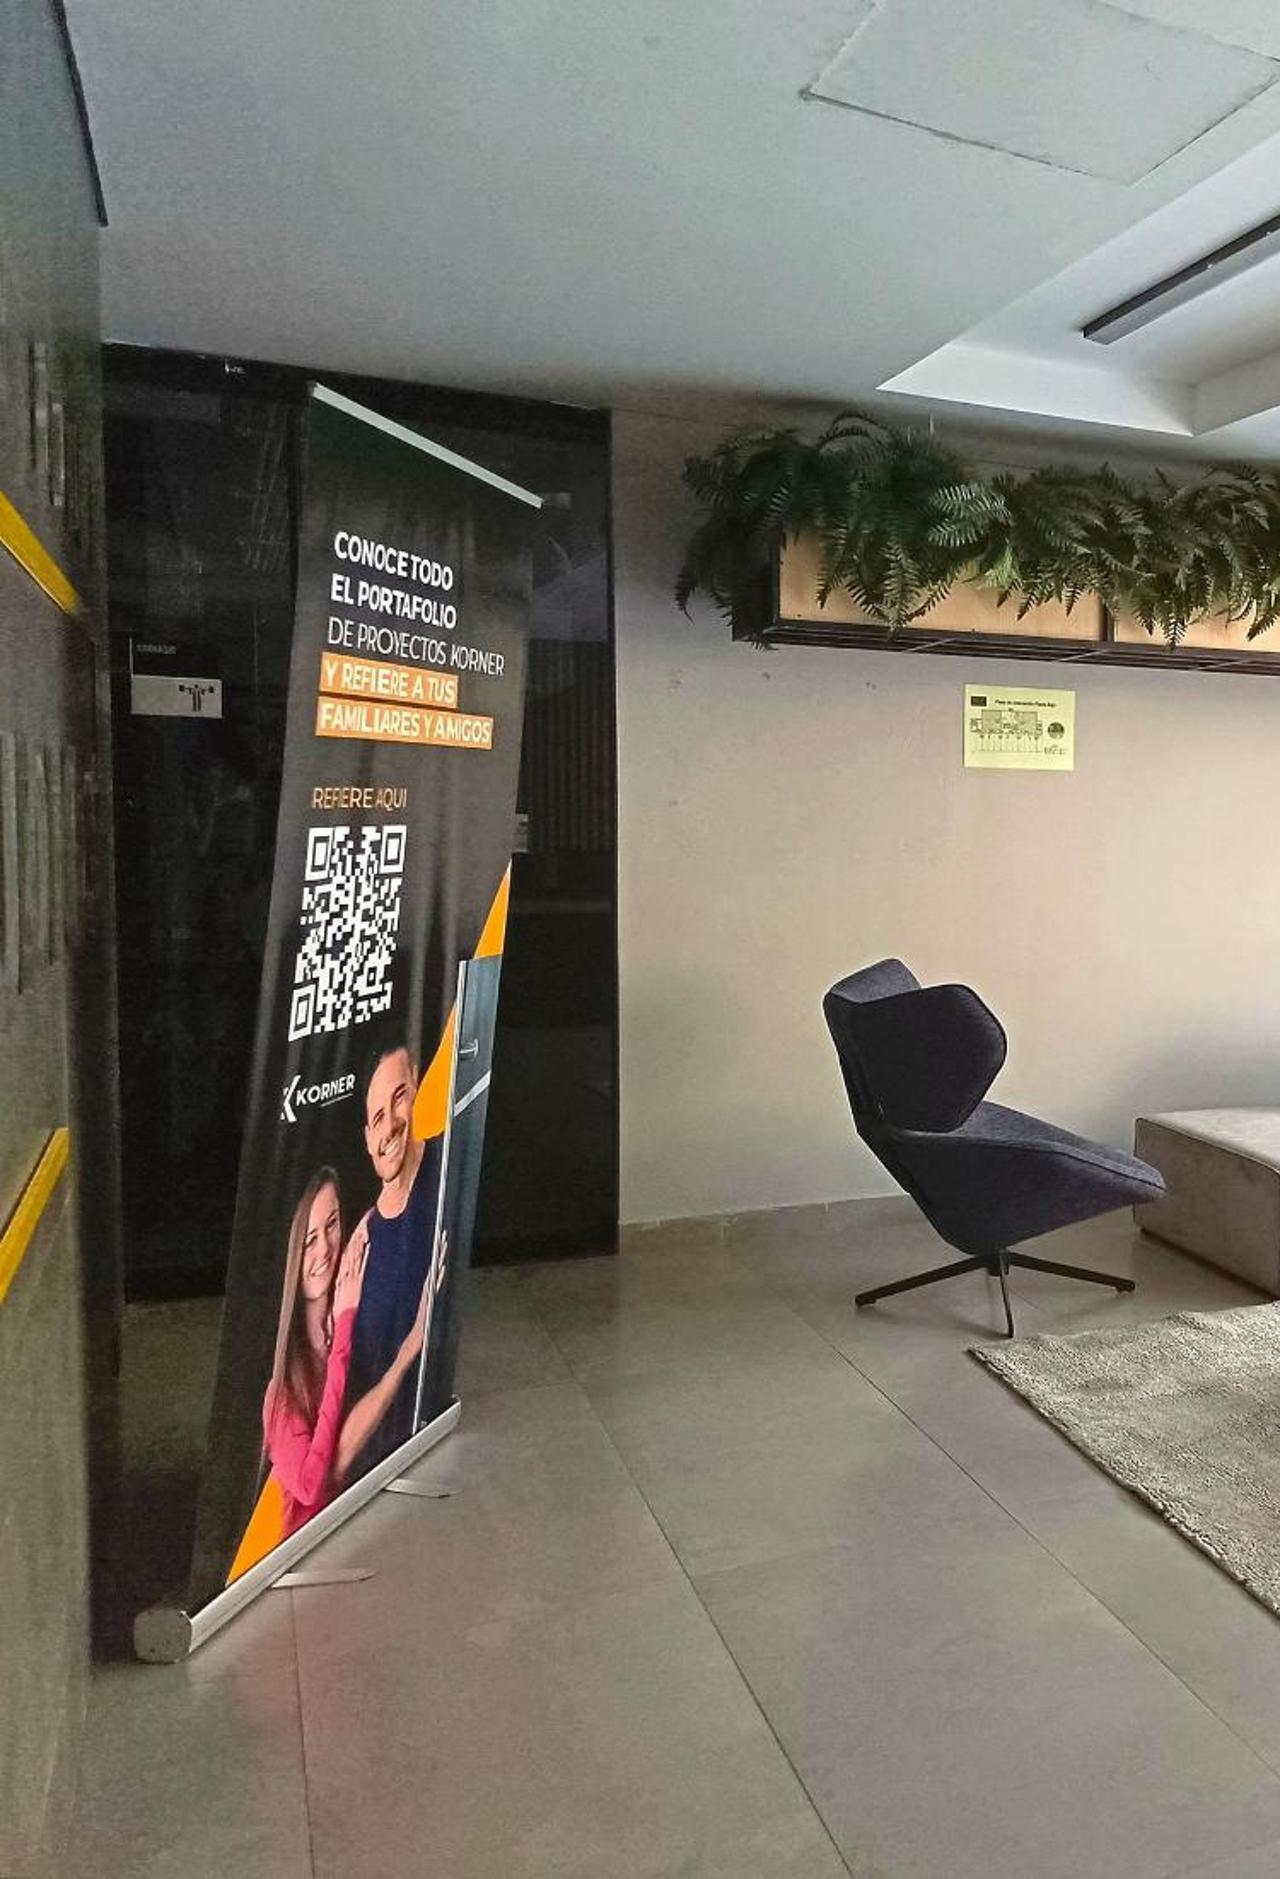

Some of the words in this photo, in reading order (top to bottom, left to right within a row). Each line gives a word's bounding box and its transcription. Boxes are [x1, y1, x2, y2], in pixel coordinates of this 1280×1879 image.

[334, 531, 408, 577] CONOCE
[410, 554, 453, 591] TODO
[331, 573, 354, 605] EL
[357, 580, 457, 629] PORTAFOLIO
[328, 616, 354, 648] DE
[357, 623, 447, 665] PROYECTOS
[450, 644, 505, 676] KORNER
[325, 660, 340, 688] Y
[342, 663, 409, 697] REFIERE
[412, 675, 424, 699] A
[427, 677, 456, 704] TUS
[320, 703, 420, 738] FAMILIARES
[423, 712, 434, 738] Y
[433, 714, 491, 743] AMIGOS
[312, 786, 374, 809] REFIERE
[375, 787, 407, 811] AQUI
[296, 1073, 355, 1107] KORNER
